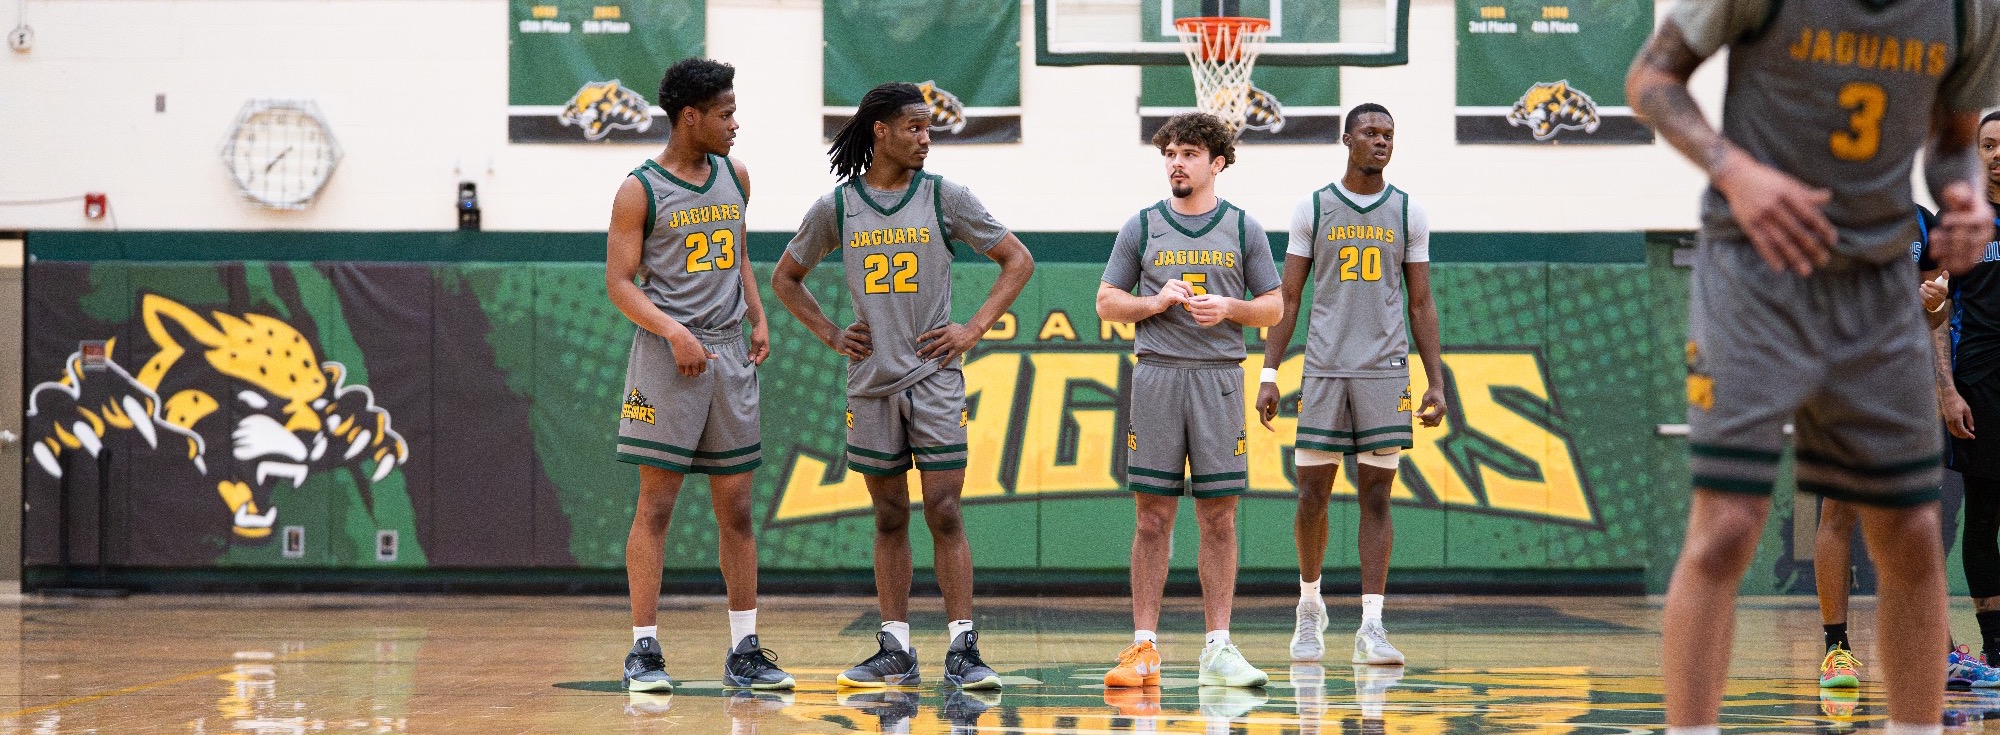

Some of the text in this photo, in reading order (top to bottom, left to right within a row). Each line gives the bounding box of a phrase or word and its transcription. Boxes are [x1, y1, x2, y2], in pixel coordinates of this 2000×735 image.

[1468, 20, 1517, 33] 3rd Place
[1531, 20, 1579, 33] 4th Place
[1789, 27, 1947, 75] JAGUARS
[1830, 81, 1887, 160] 3
[669, 204, 740, 228] JAGUARS
[850, 226, 931, 248] JAGUARS
[1327, 224, 1395, 243] JAGUARS
[685, 228, 735, 274] 23
[1154, 249, 1235, 268] JAGUARS
[1338, 245, 1383, 282] 20
[863, 252, 919, 294] 22
[1181, 272, 1208, 312] 5
